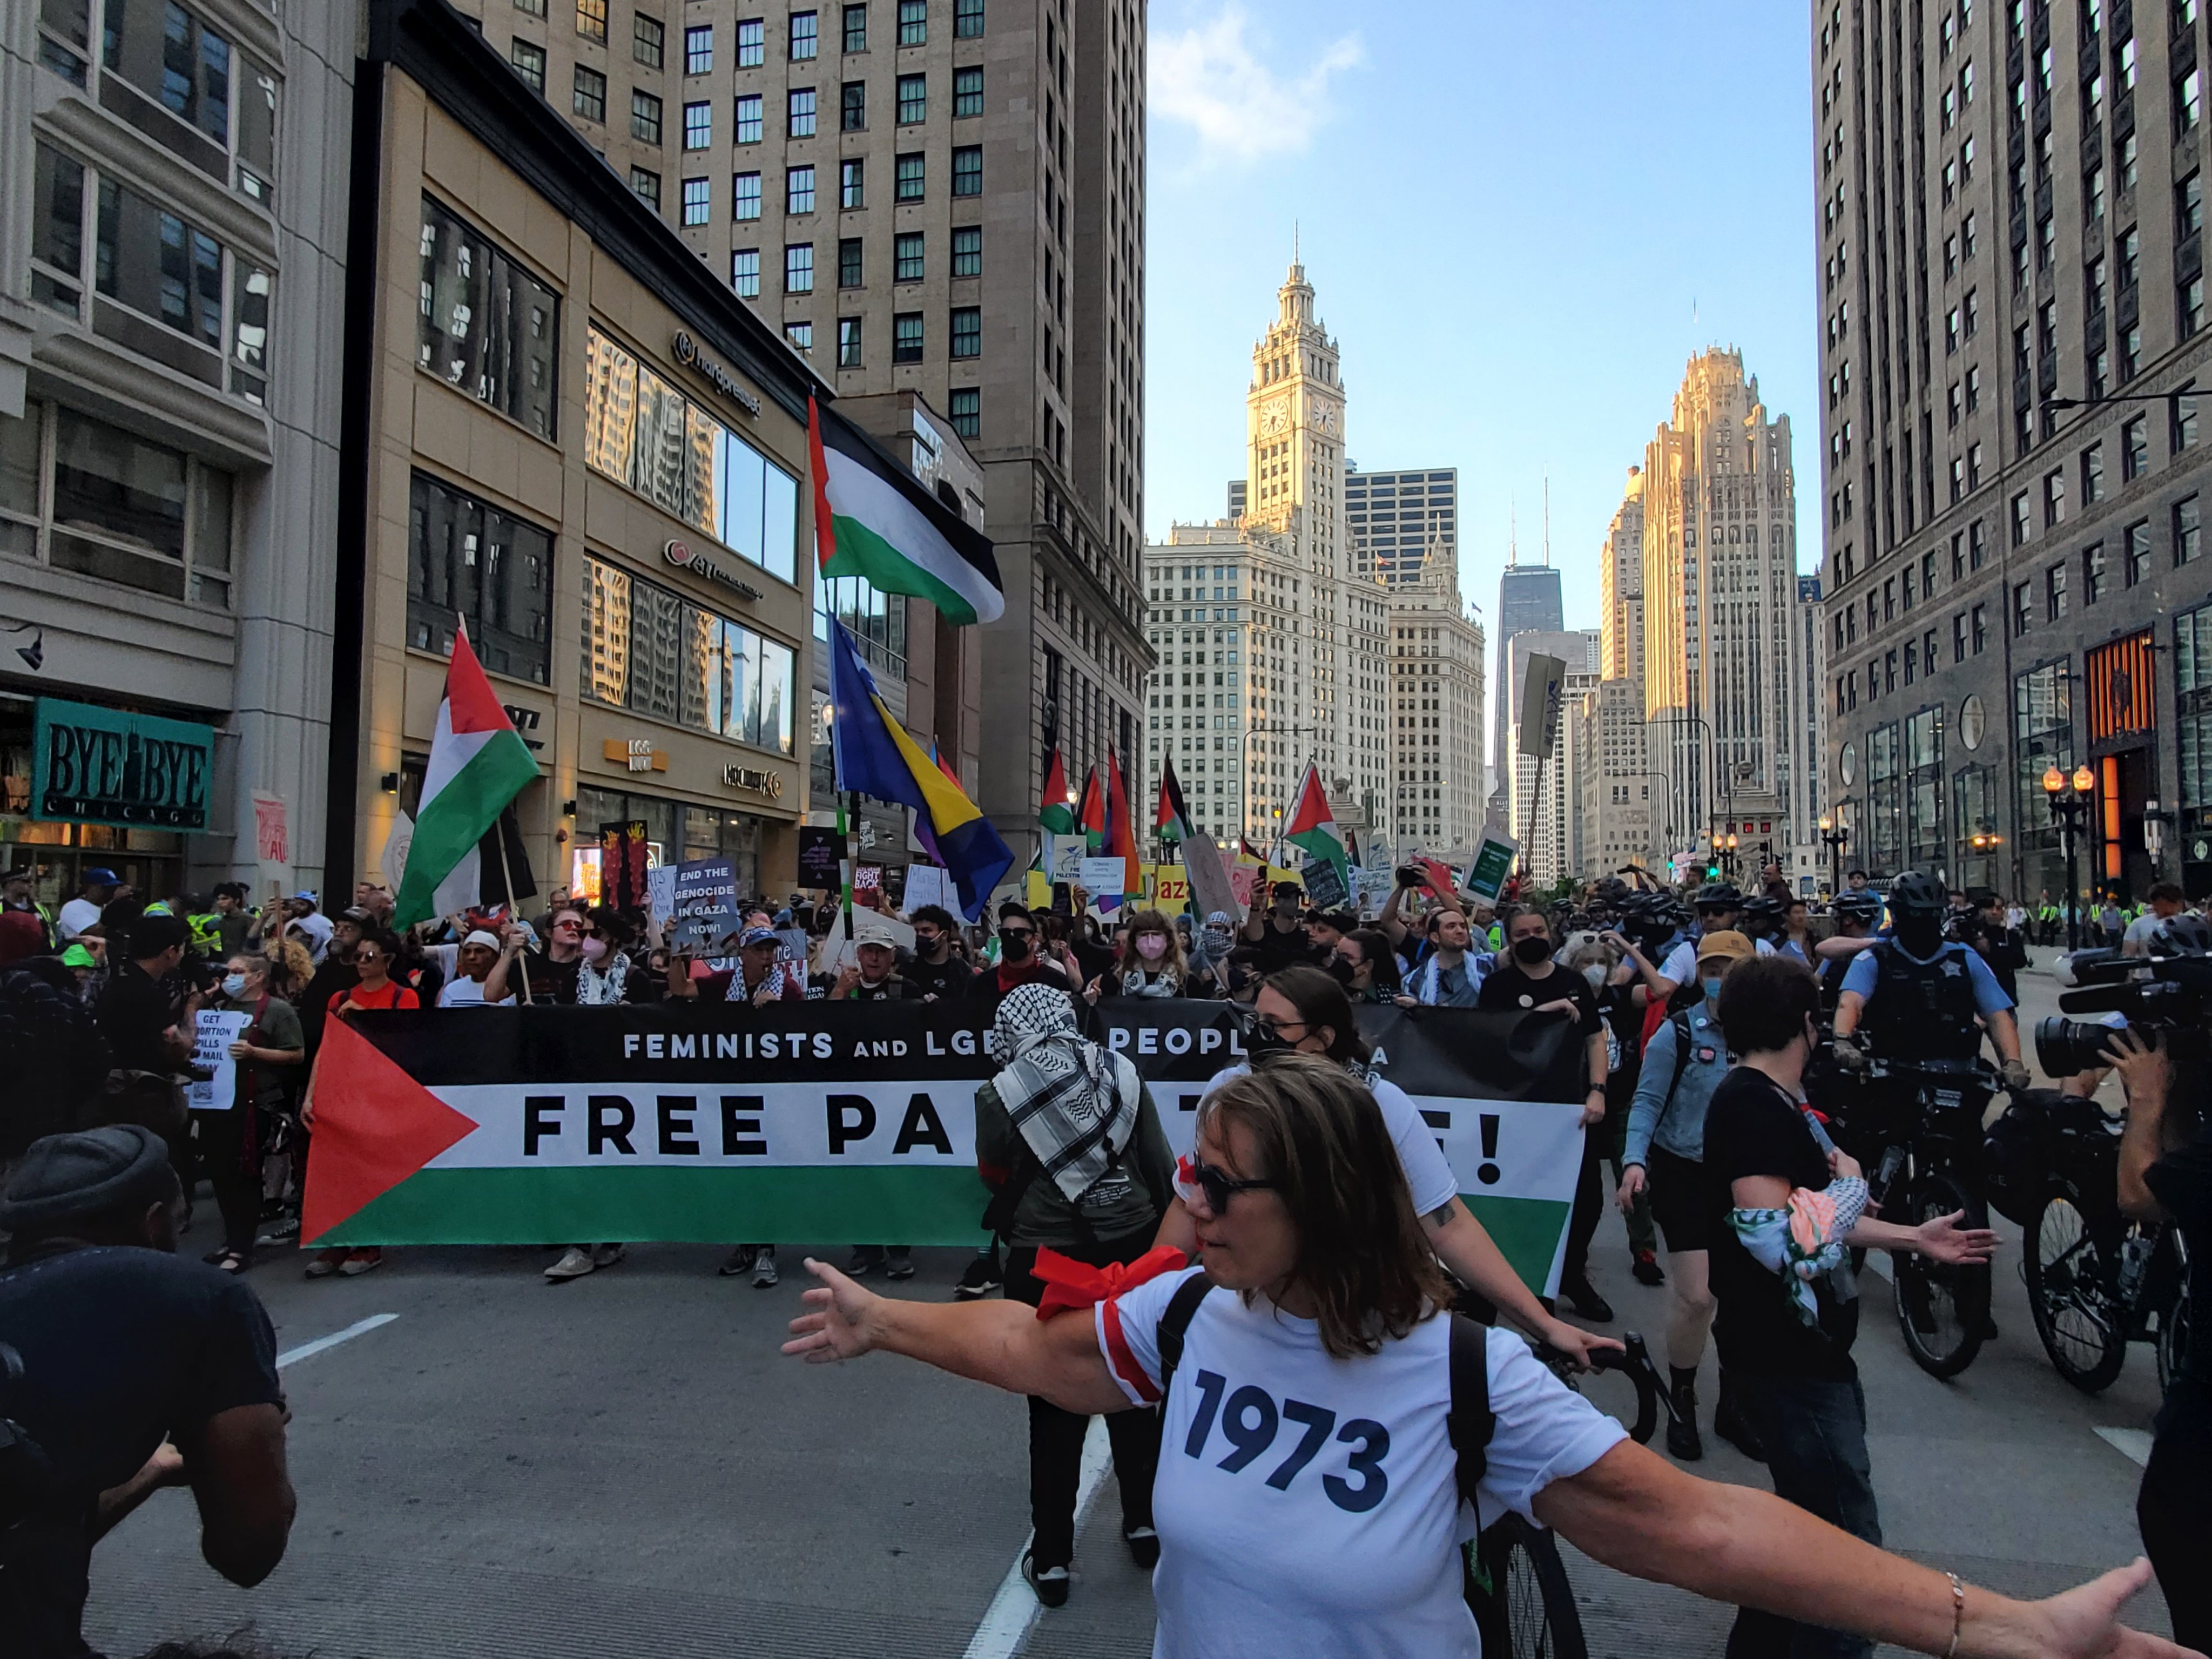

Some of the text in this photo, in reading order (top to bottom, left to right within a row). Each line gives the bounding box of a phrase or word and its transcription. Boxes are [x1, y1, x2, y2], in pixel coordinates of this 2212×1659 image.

[48, 723, 207, 808] BYE BYE
[47, 800, 201, 824] CHICAGO
[680, 867, 729, 881] END THE
[856, 872, 880, 880] FIGHT
[855, 880, 878, 888] BACK
[675, 886, 735, 900] GENOCIDE
[678, 905, 728, 917] IN GAZA
[689, 924, 721, 935] NOW!
[203, 1015, 220, 1023] GET
[624, 1033, 833, 1058] FEMINISTS
[853, 1040, 908, 1057] AND
[1109, 1027, 1248, 1055] PEOPL
[203, 1051, 223, 1060] MAIL
[524, 1095, 767, 1156] FREE
[1184, 1368, 1390, 1513] 1973
